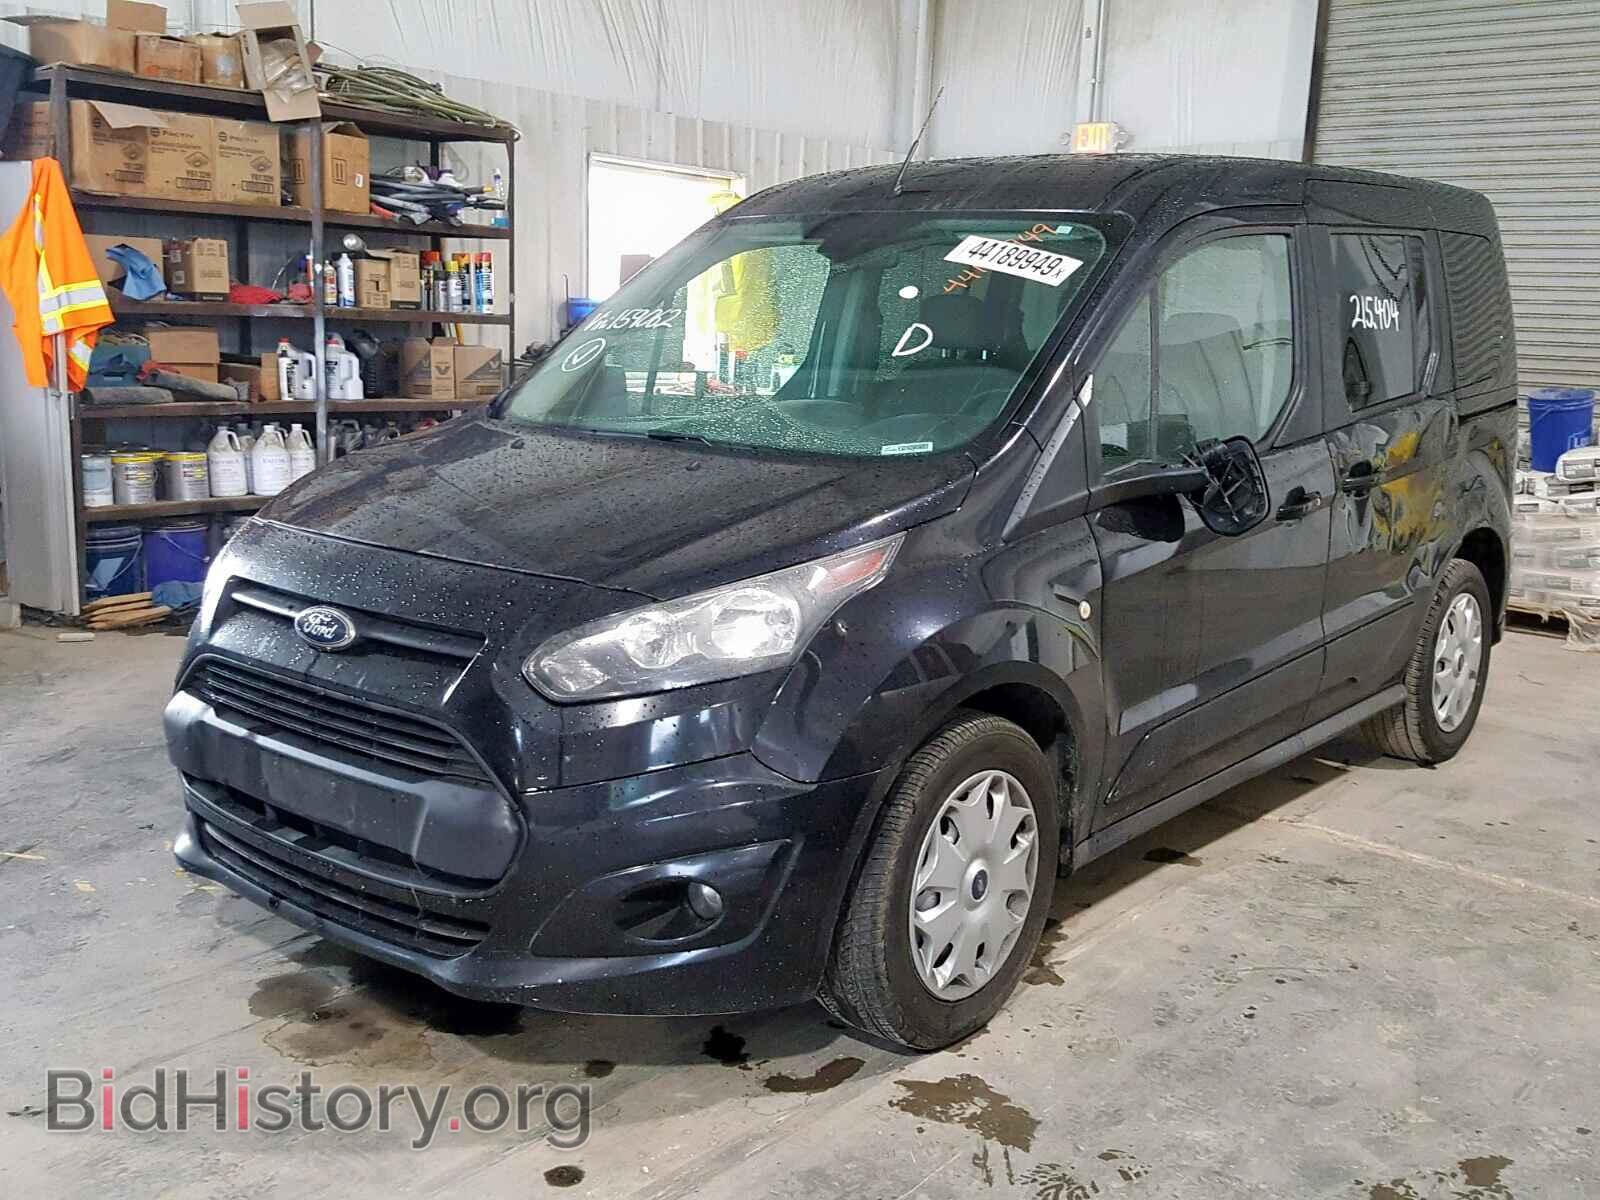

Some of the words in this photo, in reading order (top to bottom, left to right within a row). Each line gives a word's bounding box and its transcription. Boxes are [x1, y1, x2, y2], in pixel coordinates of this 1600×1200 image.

[968, 240, 1064, 276] 44189949
[891, 322, 934, 357] D
[303, 612, 339, 639] Ford
